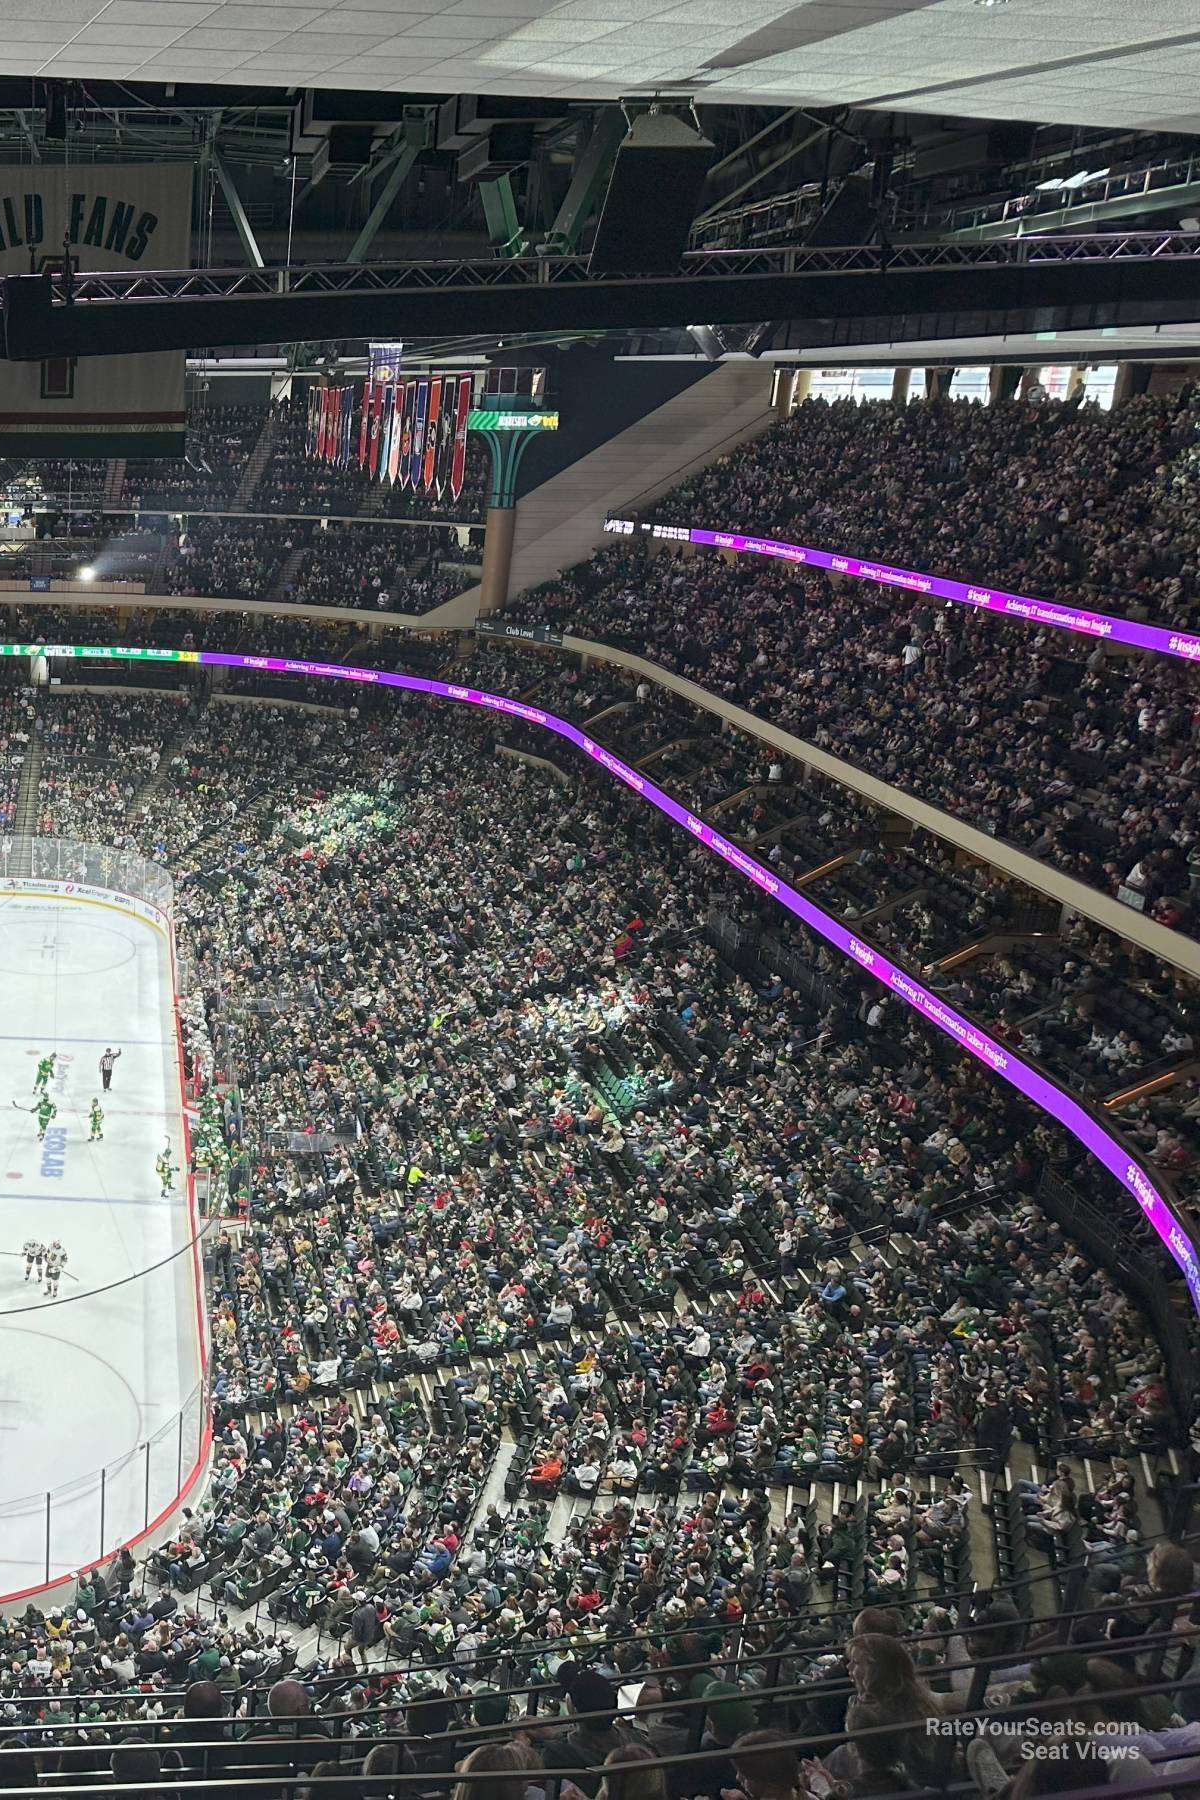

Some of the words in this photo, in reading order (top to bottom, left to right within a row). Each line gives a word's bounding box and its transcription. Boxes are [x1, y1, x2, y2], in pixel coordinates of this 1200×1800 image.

[70, 194, 158, 261] FANS
[506, 626, 519, 636] Club
[520, 628, 534, 638] Level
[890, 972, 918, 1003] Achieving
[924, 998, 966, 1038] transformation
[967, 1031, 983, 1051] takes
[984, 1043, 1008, 1070] Insight
[40, 1128, 67, 1177] ECOLAB
